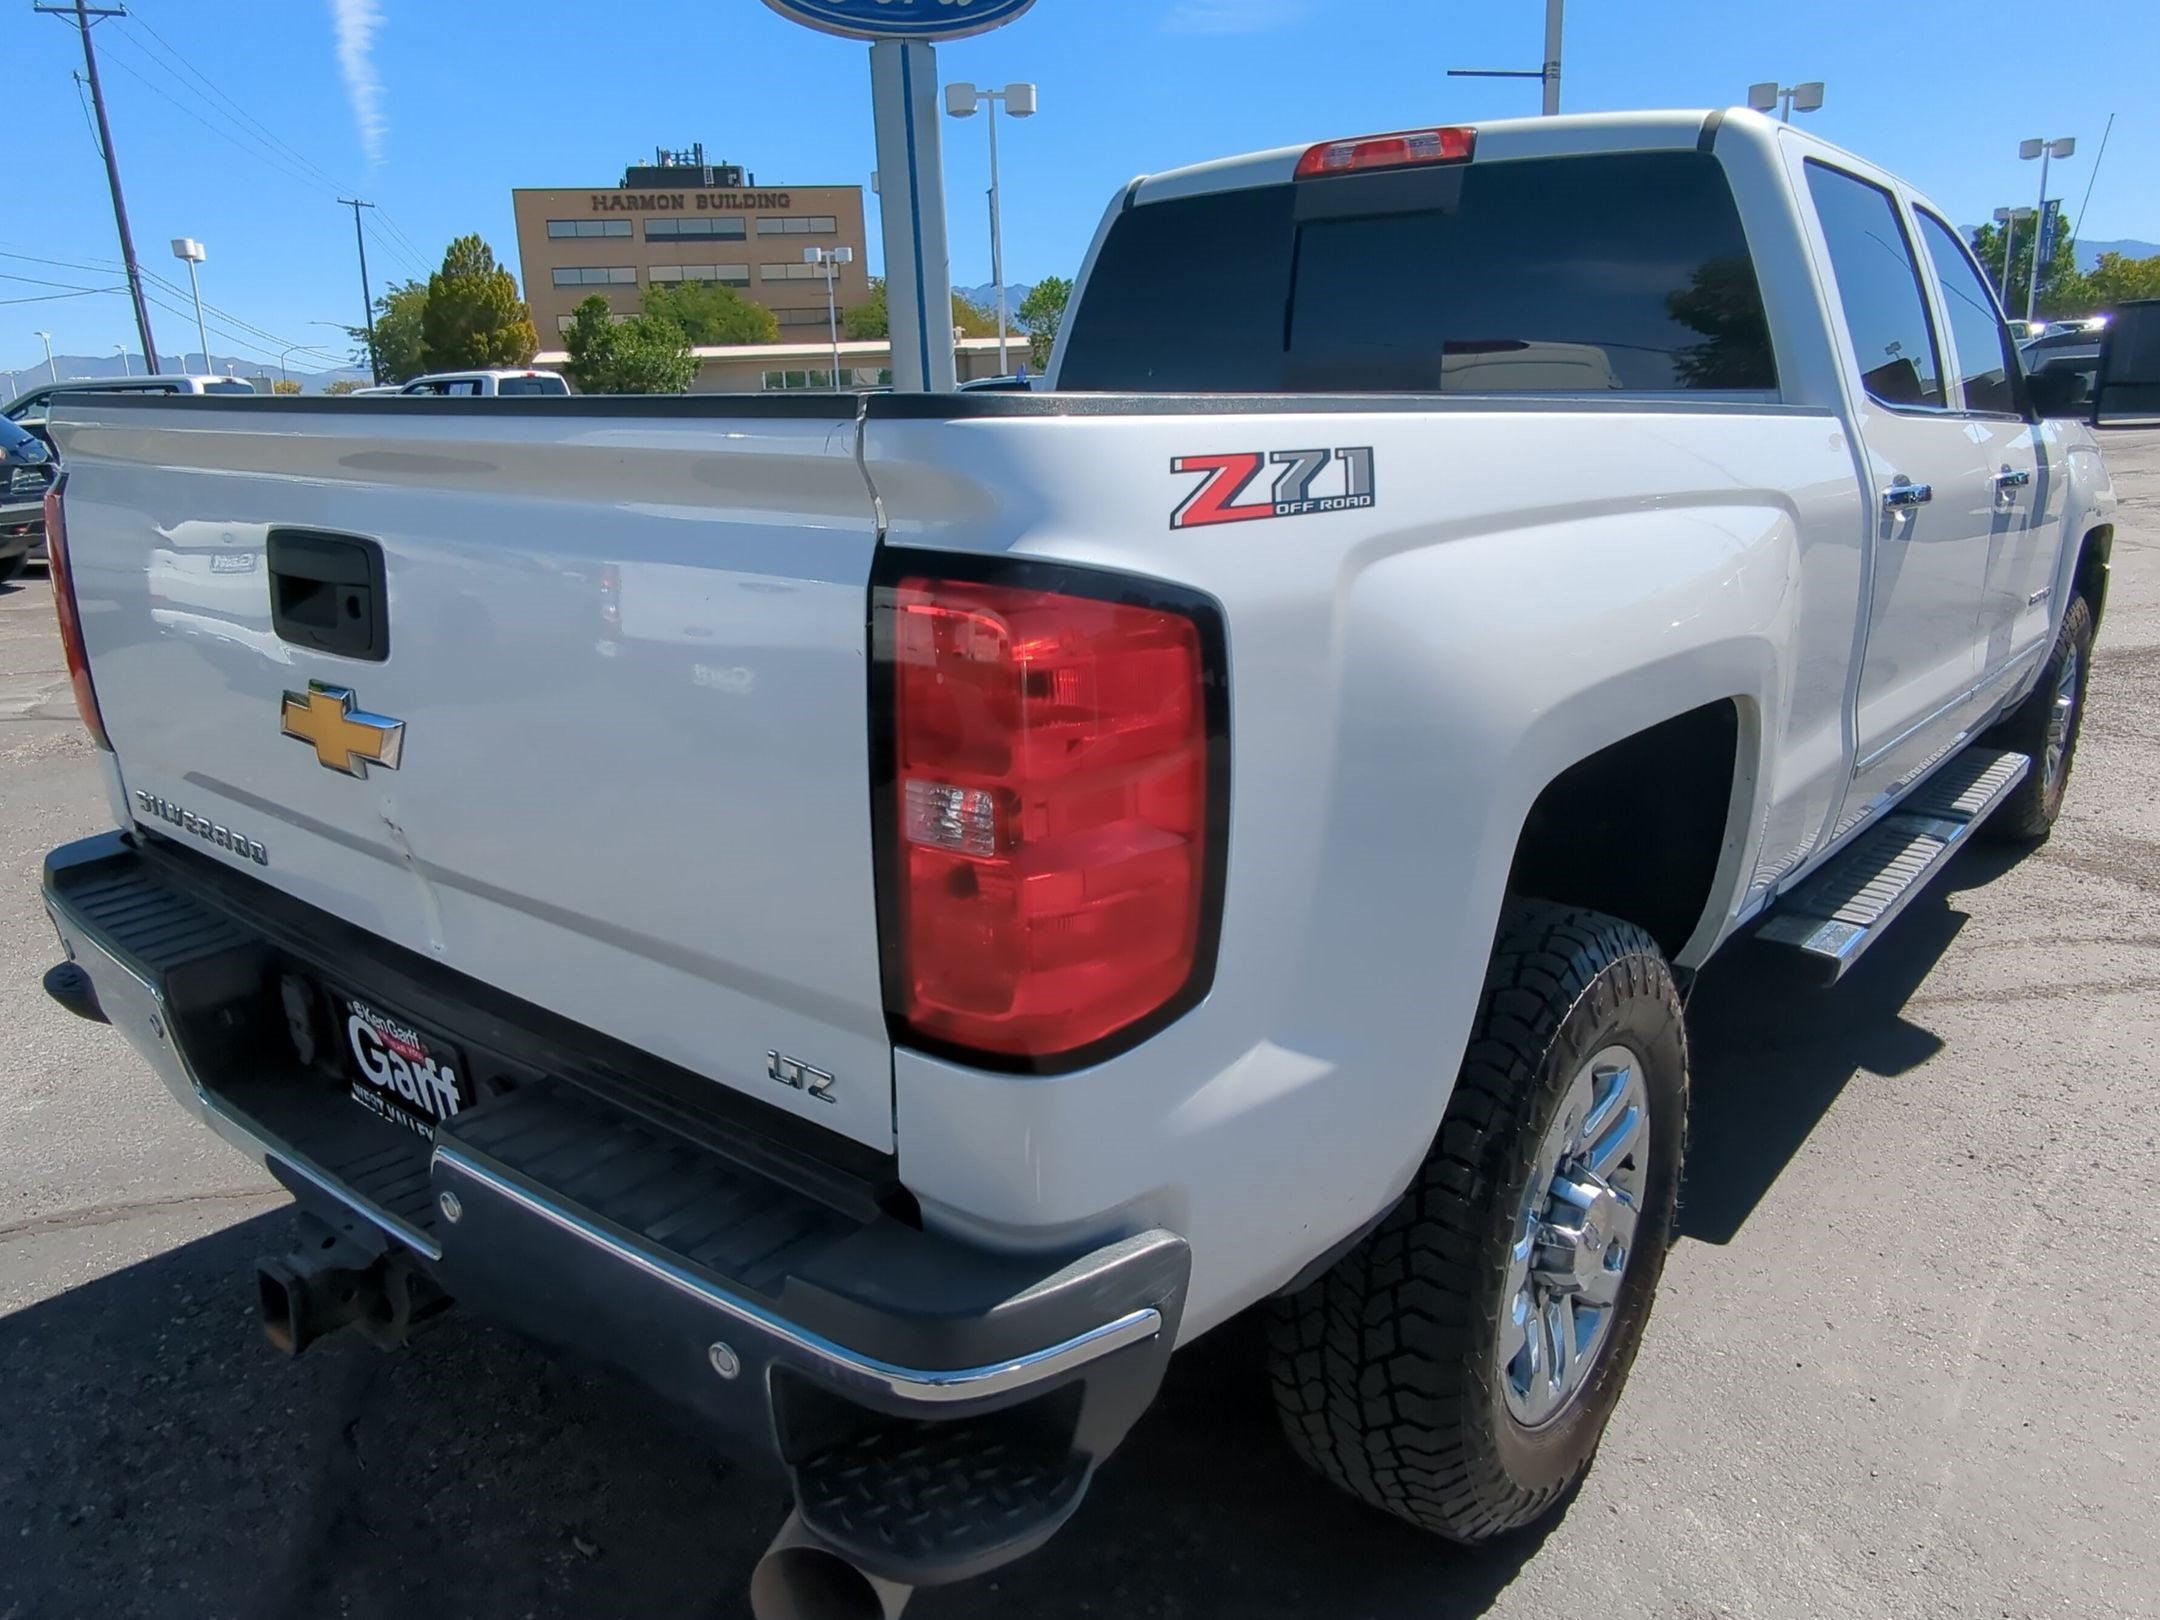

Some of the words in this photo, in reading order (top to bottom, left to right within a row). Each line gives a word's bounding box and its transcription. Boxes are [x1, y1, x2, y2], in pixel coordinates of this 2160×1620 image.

[591, 194, 685, 211] HARMON
[695, 193, 791, 210] BUILDING
[1169, 446, 1376, 530] Z71
[1275, 502, 1314, 515] OFF
[1319, 495, 1371, 510] ROAD
[136, 789, 268, 866] SILVERADO
[388, 1019, 420, 1050] Garff
[349, 1015, 461, 1121] Garff
[767, 1049, 837, 1105] LTZ
[352, 1081, 384, 1112] WEST
